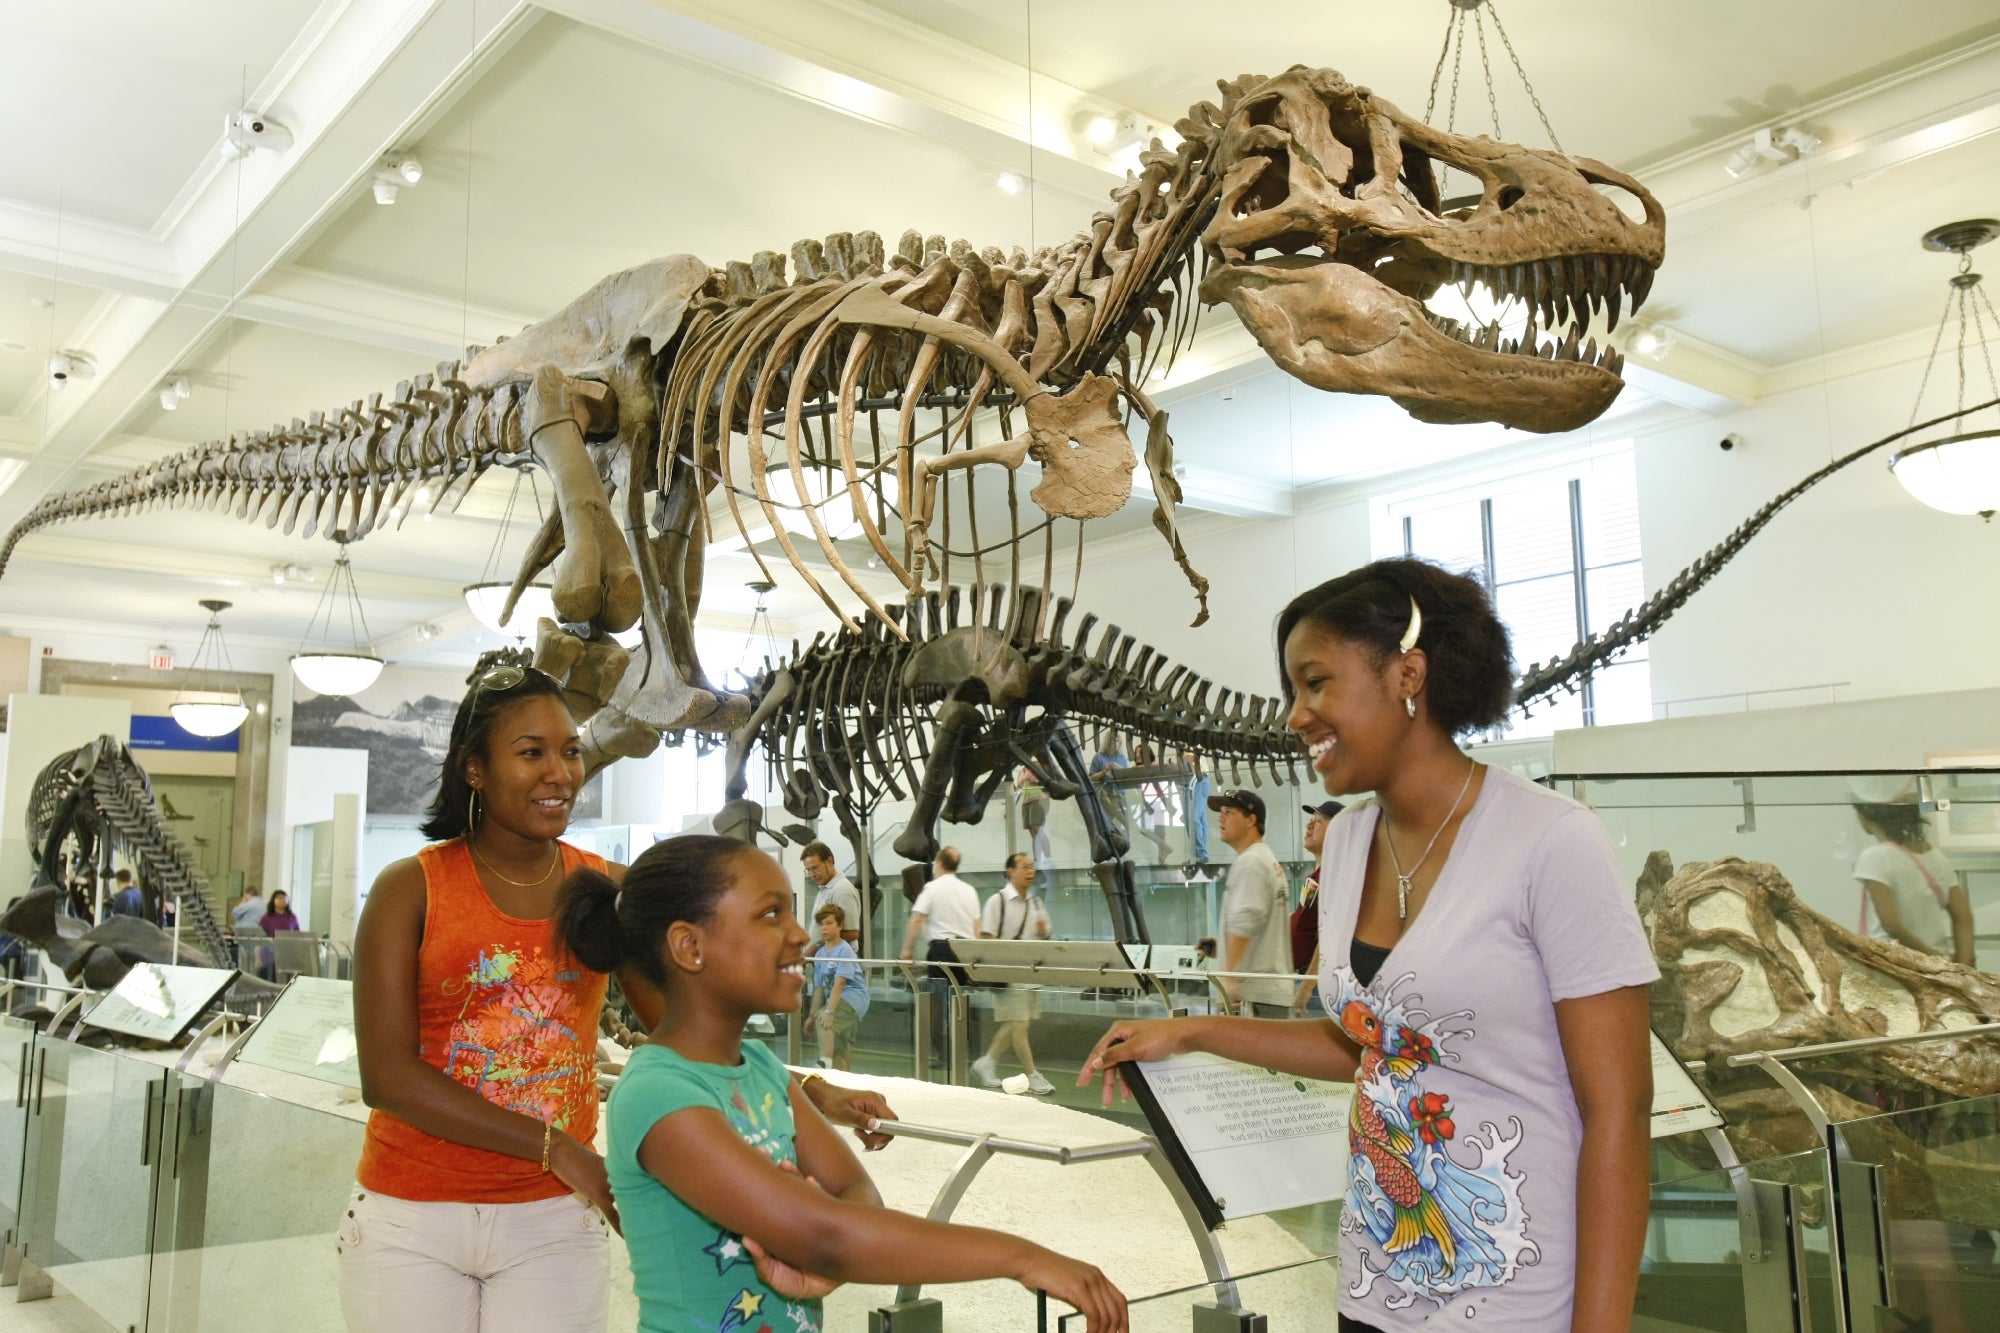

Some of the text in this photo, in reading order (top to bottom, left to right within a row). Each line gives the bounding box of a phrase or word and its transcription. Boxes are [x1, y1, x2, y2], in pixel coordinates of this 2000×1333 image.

[153, 655, 172, 668] EXIT
[1157, 1076, 1171, 1084] The
[1174, 1075, 1192, 1083] arms
[1193, 1072, 1202, 1080] of
[1202, 1069, 1252, 1081] Tyrannosaurus
[1159, 1085, 1194, 1096] Scientists
[1194, 1081, 1224, 1092] thought
[1224, 1078, 1240, 1087] that
[1215, 1090, 1226, 1099] the
[1226, 1088, 1250, 1098] hands
[1250, 1086, 1258, 1095] of
[1260, 1084, 1294, 1094] Allosaurus
[1184, 1087, 1350, 1114] until specimens were discovered which showed
[1224, 1102, 1326, 1120] that all advanced tyrannosaurs
[1216, 1122, 1245, 1134] (among
[1245, 1120, 1264, 1130] them
[1284, 1114, 1298, 1123] and
[1230, 1133, 1246, 1142] had
[1247, 1130, 1262, 1140] only
[1269, 1126, 1295, 1137] fingers
[1306, 1122, 1322, 1131] each
